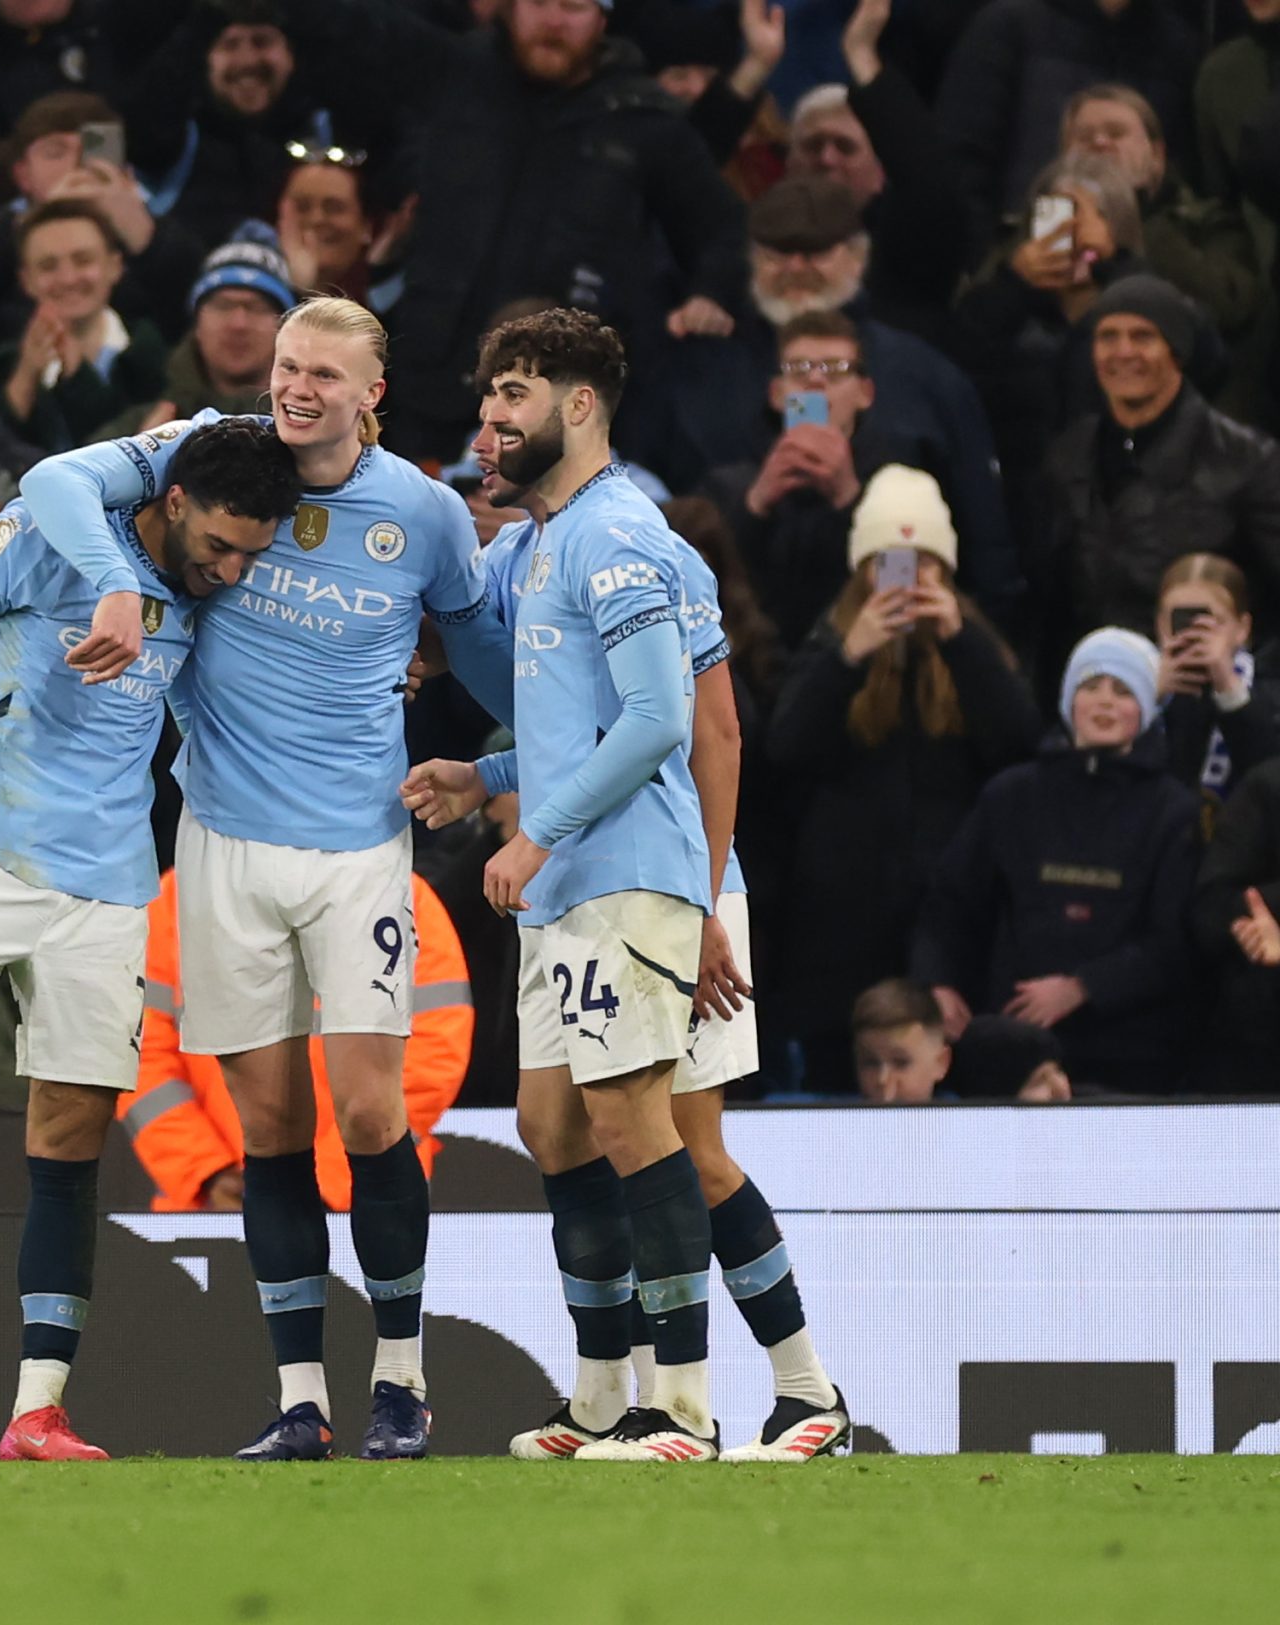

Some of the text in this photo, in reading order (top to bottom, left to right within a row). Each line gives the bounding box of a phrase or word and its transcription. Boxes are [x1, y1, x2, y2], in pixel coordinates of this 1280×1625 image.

[238, 592, 346, 637] AIRWAYS
[244, 560, 394, 618] TIHAD
[373, 915, 402, 976] 9
[553, 959, 620, 1025] 24
